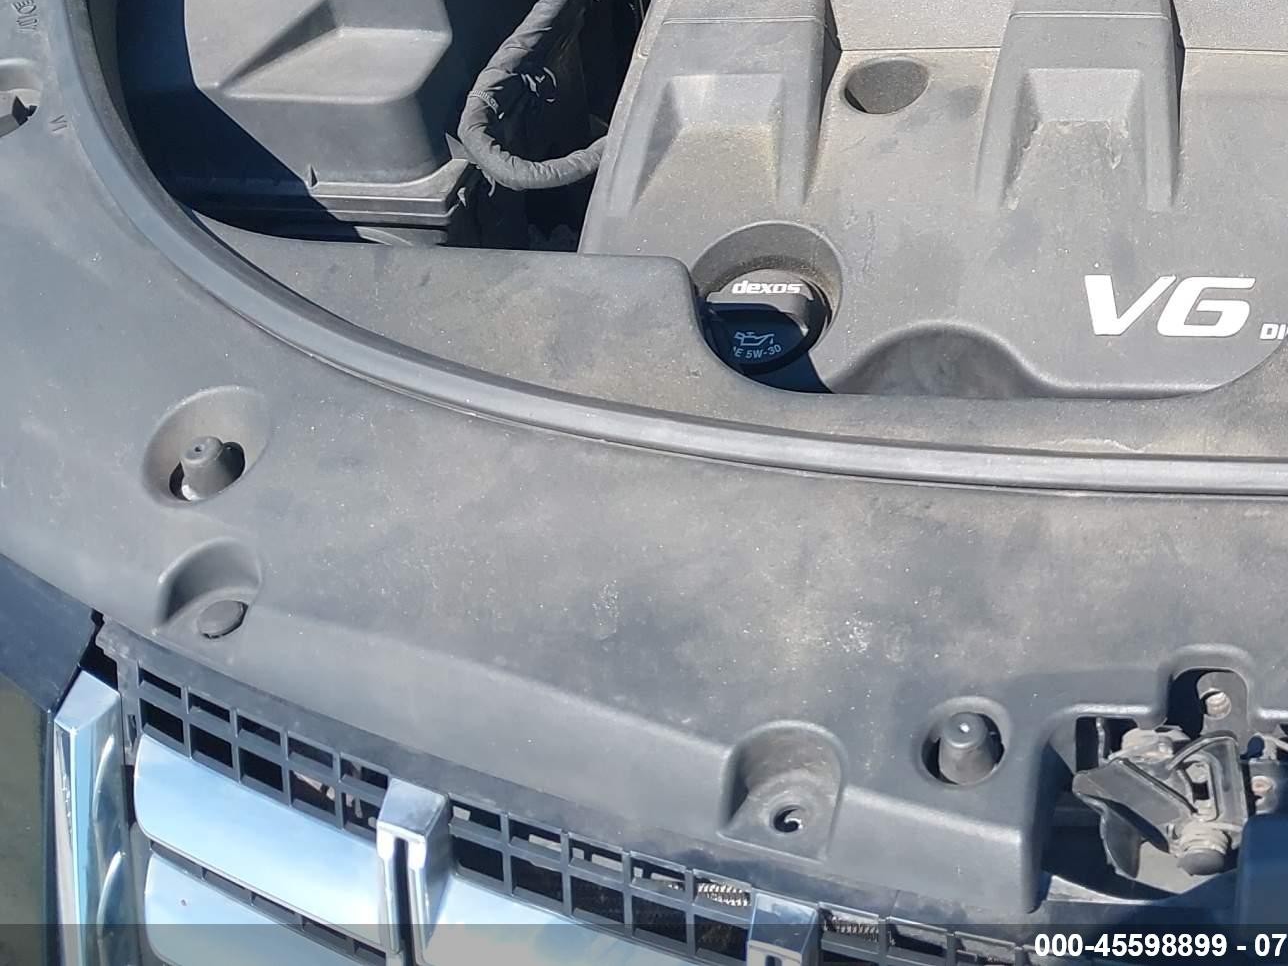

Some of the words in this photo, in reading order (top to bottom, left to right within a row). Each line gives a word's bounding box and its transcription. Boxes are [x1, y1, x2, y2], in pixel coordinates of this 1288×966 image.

[731, 280, 804, 294] dexos
[1085, 274, 1256, 337] V6
[745, 344, 782, 359] 5W-30
